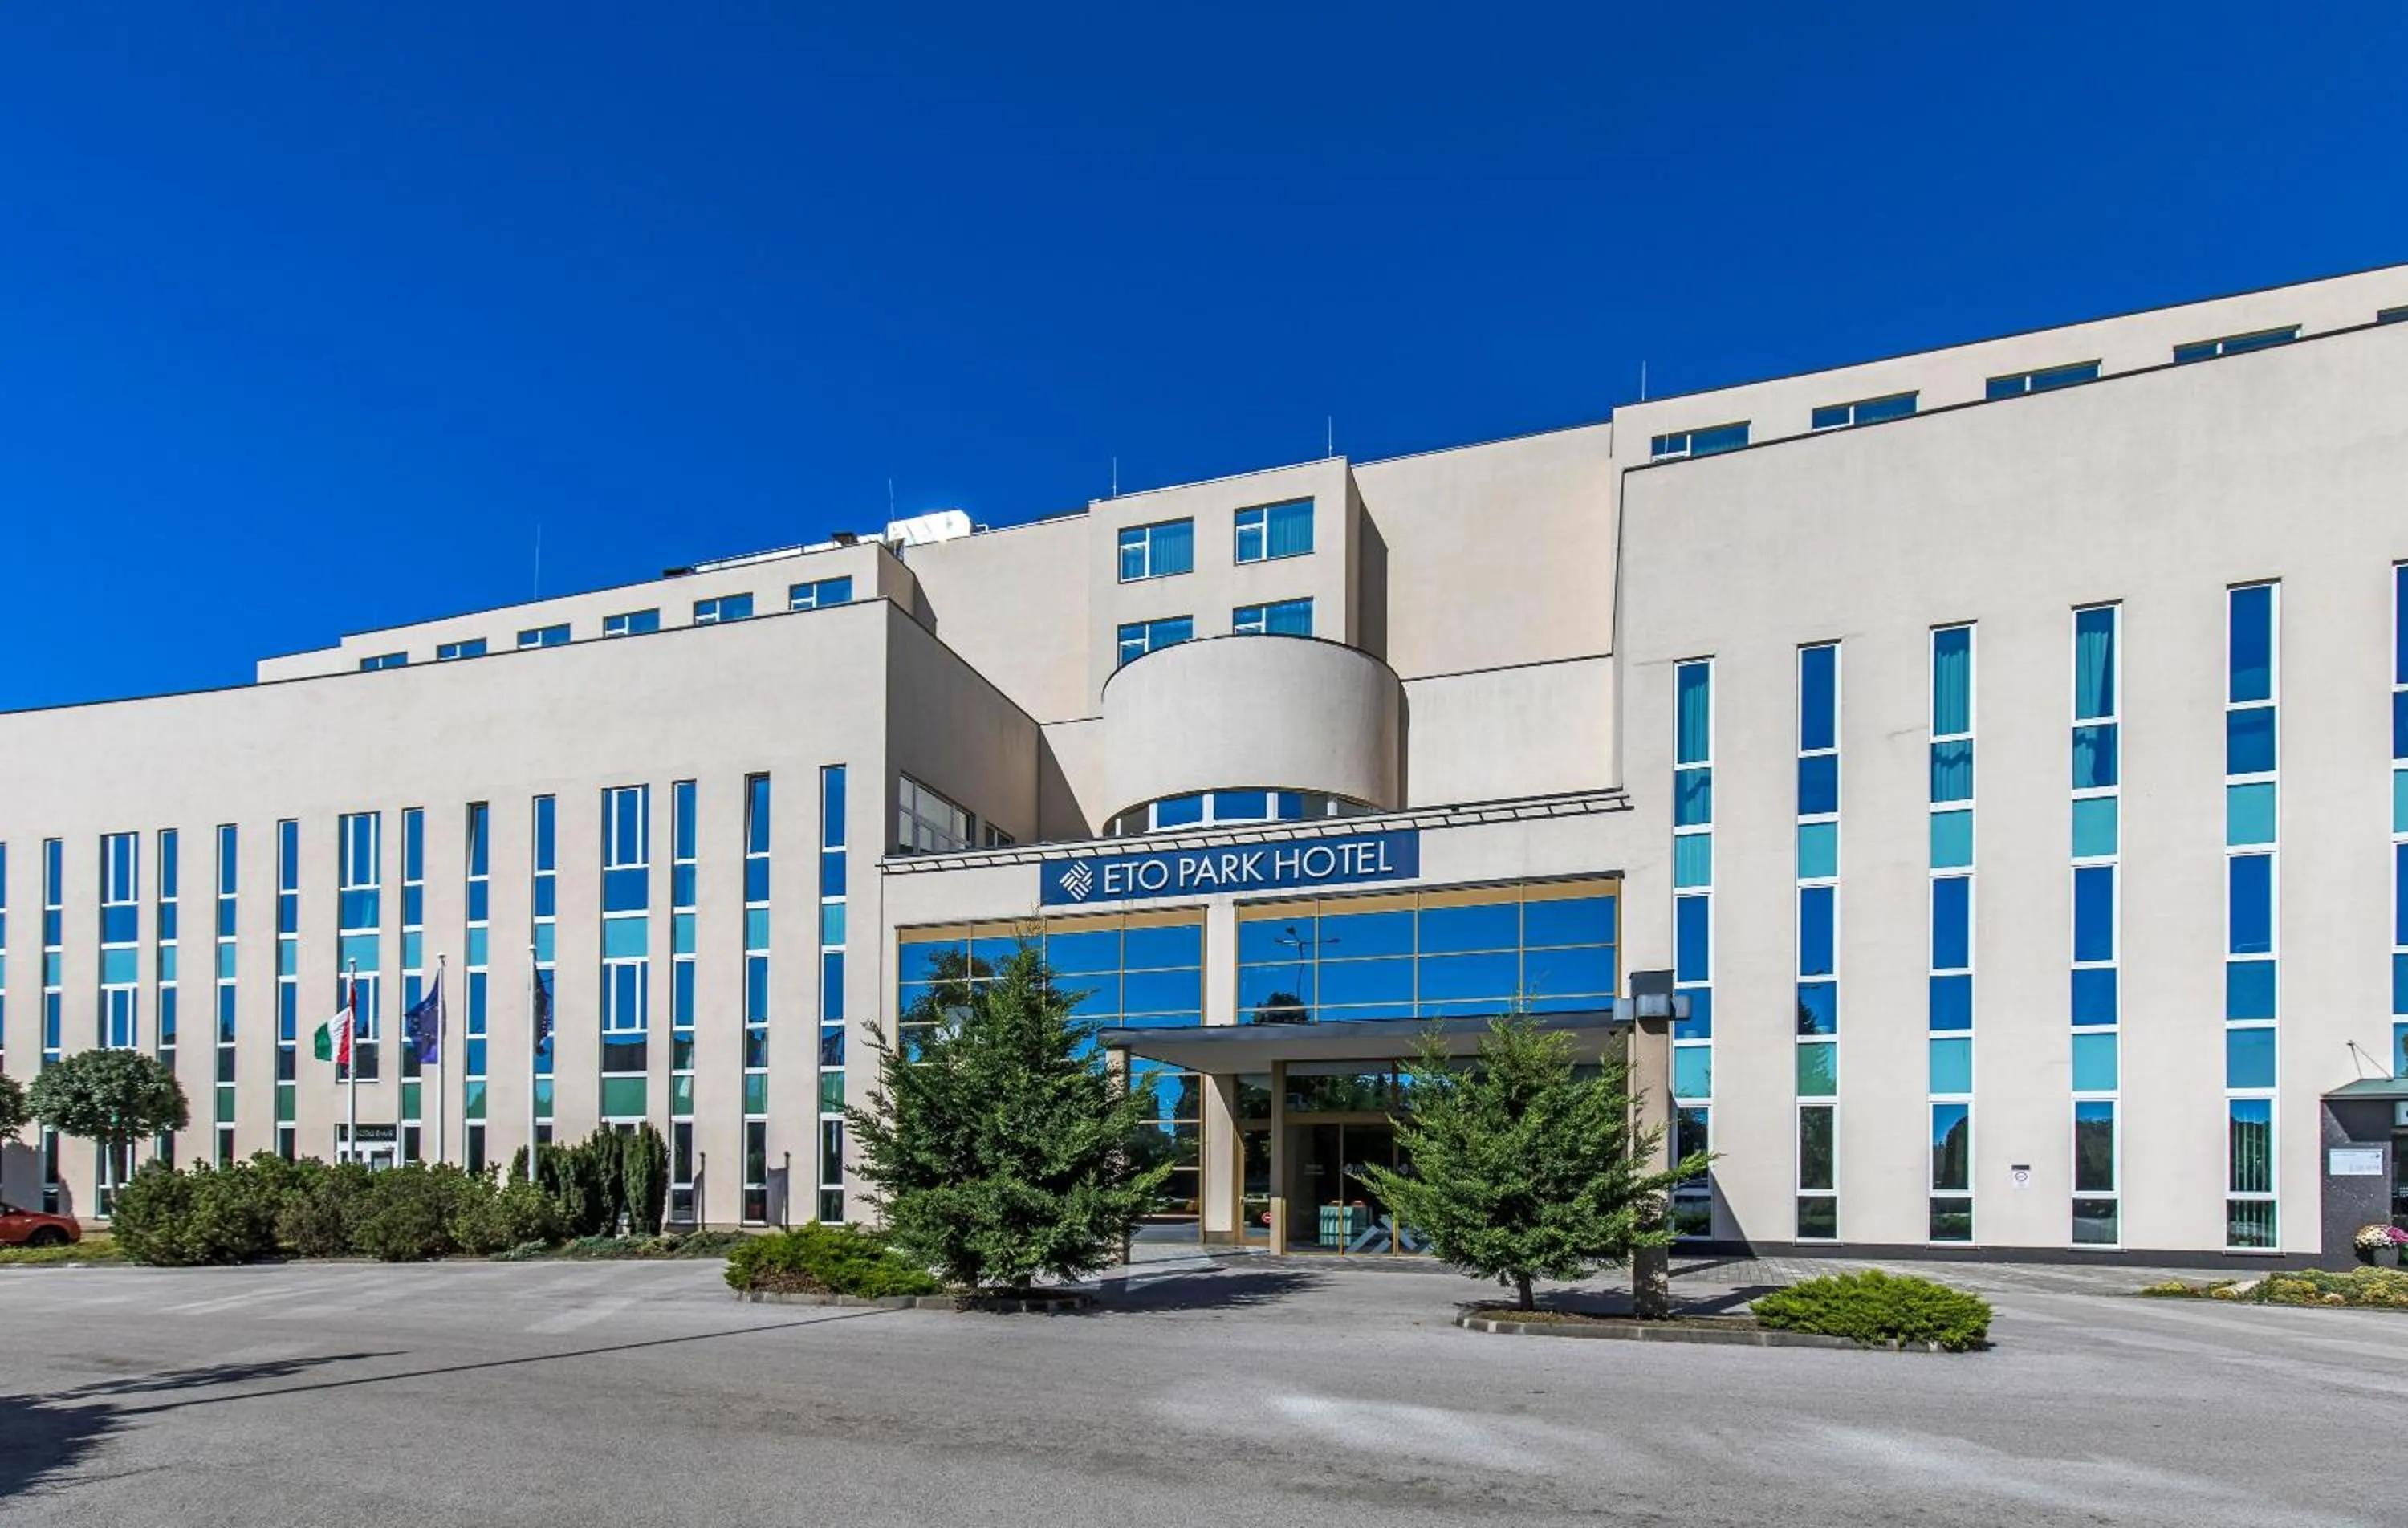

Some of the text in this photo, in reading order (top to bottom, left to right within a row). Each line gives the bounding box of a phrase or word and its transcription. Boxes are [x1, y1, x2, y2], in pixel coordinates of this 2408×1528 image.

[1104, 840, 1393, 893] ETO PARK HOTEL
